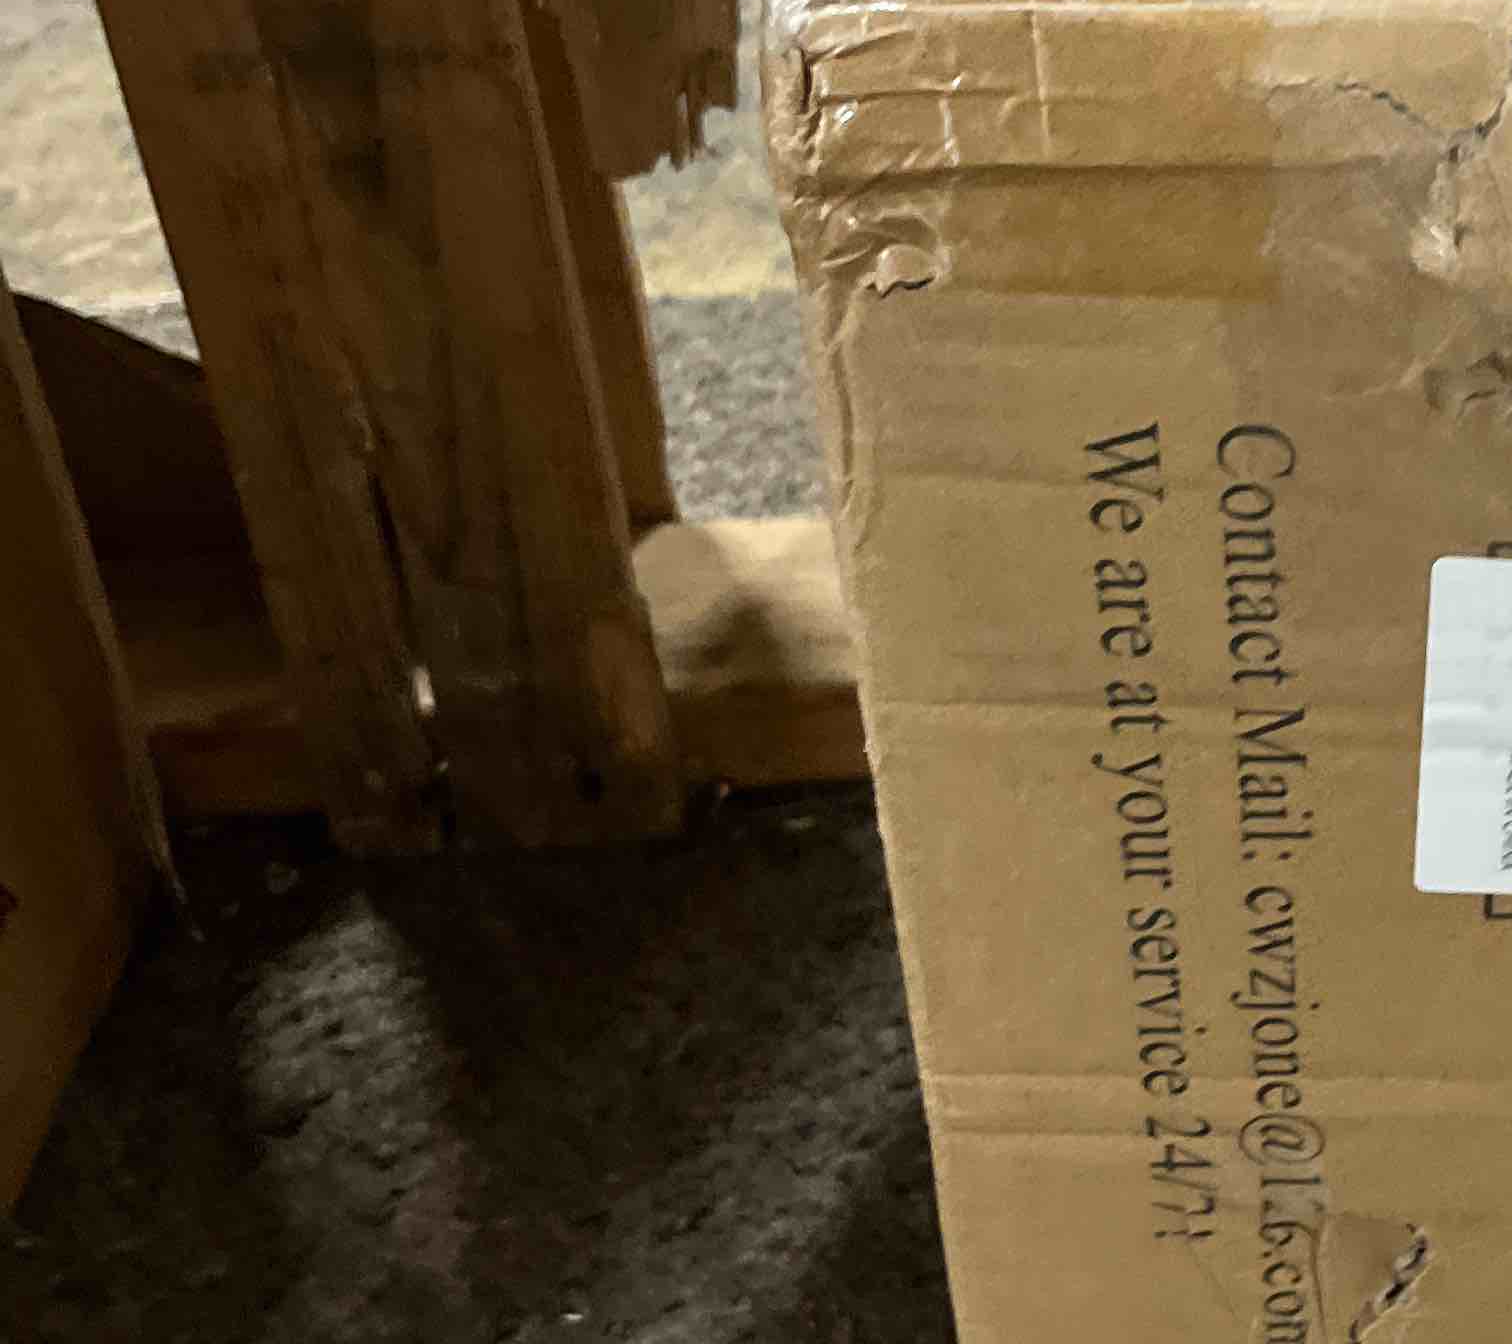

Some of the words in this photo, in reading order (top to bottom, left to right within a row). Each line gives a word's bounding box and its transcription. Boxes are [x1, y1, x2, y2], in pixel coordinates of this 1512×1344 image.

[1083, 420, 1165, 534] We
[1094, 558, 1154, 657] are
[1216, 423, 1298, 687] Contact
[1104, 680, 1173, 735] at
[1091, 752, 1173, 890] your
[1233, 704, 1315, 862] Mail:
[1126, 907, 1208, 1099] service
[1145, 1116, 1219, 1240] 24/7!
